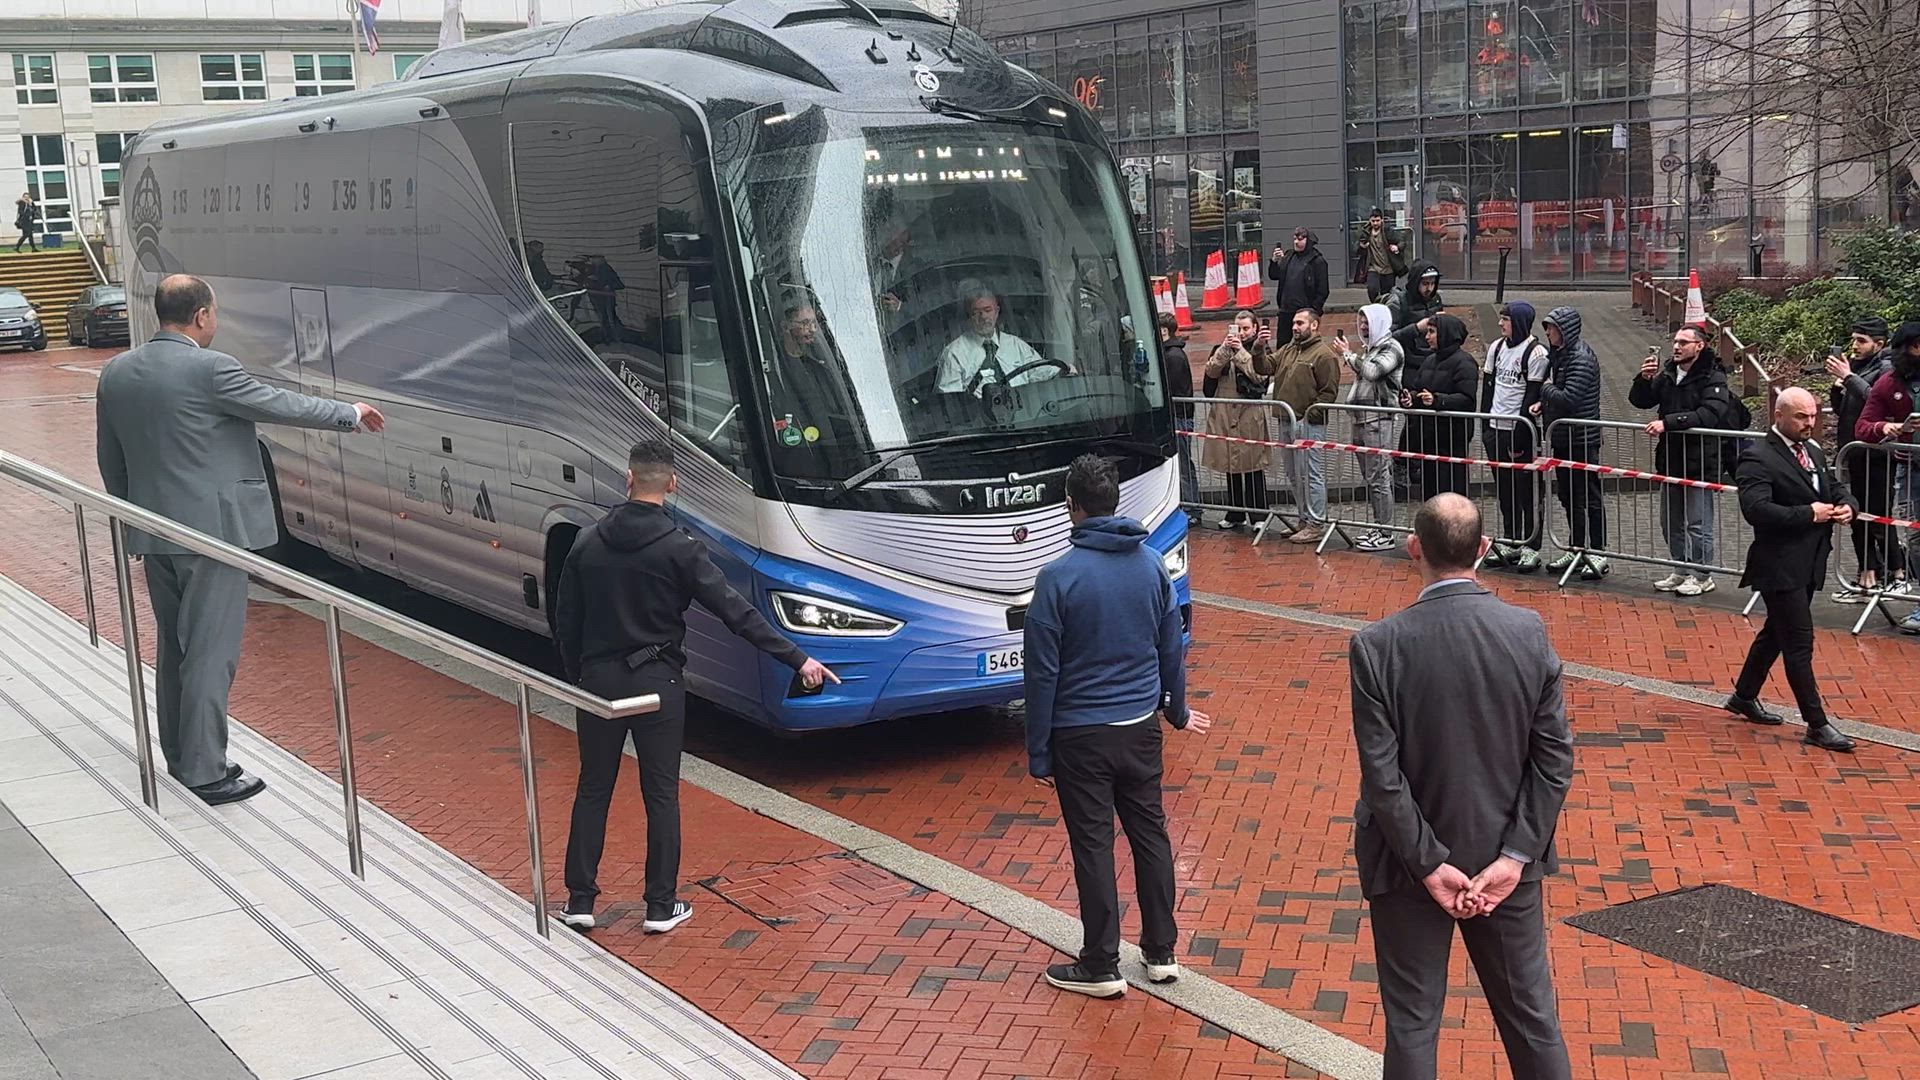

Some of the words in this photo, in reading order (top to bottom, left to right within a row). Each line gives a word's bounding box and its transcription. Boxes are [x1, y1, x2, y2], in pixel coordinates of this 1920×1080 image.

[264, 183, 271, 211] 6
[303, 182, 310, 210] 9
[342, 179, 357, 210] 36
[380, 178, 392, 210] 15
